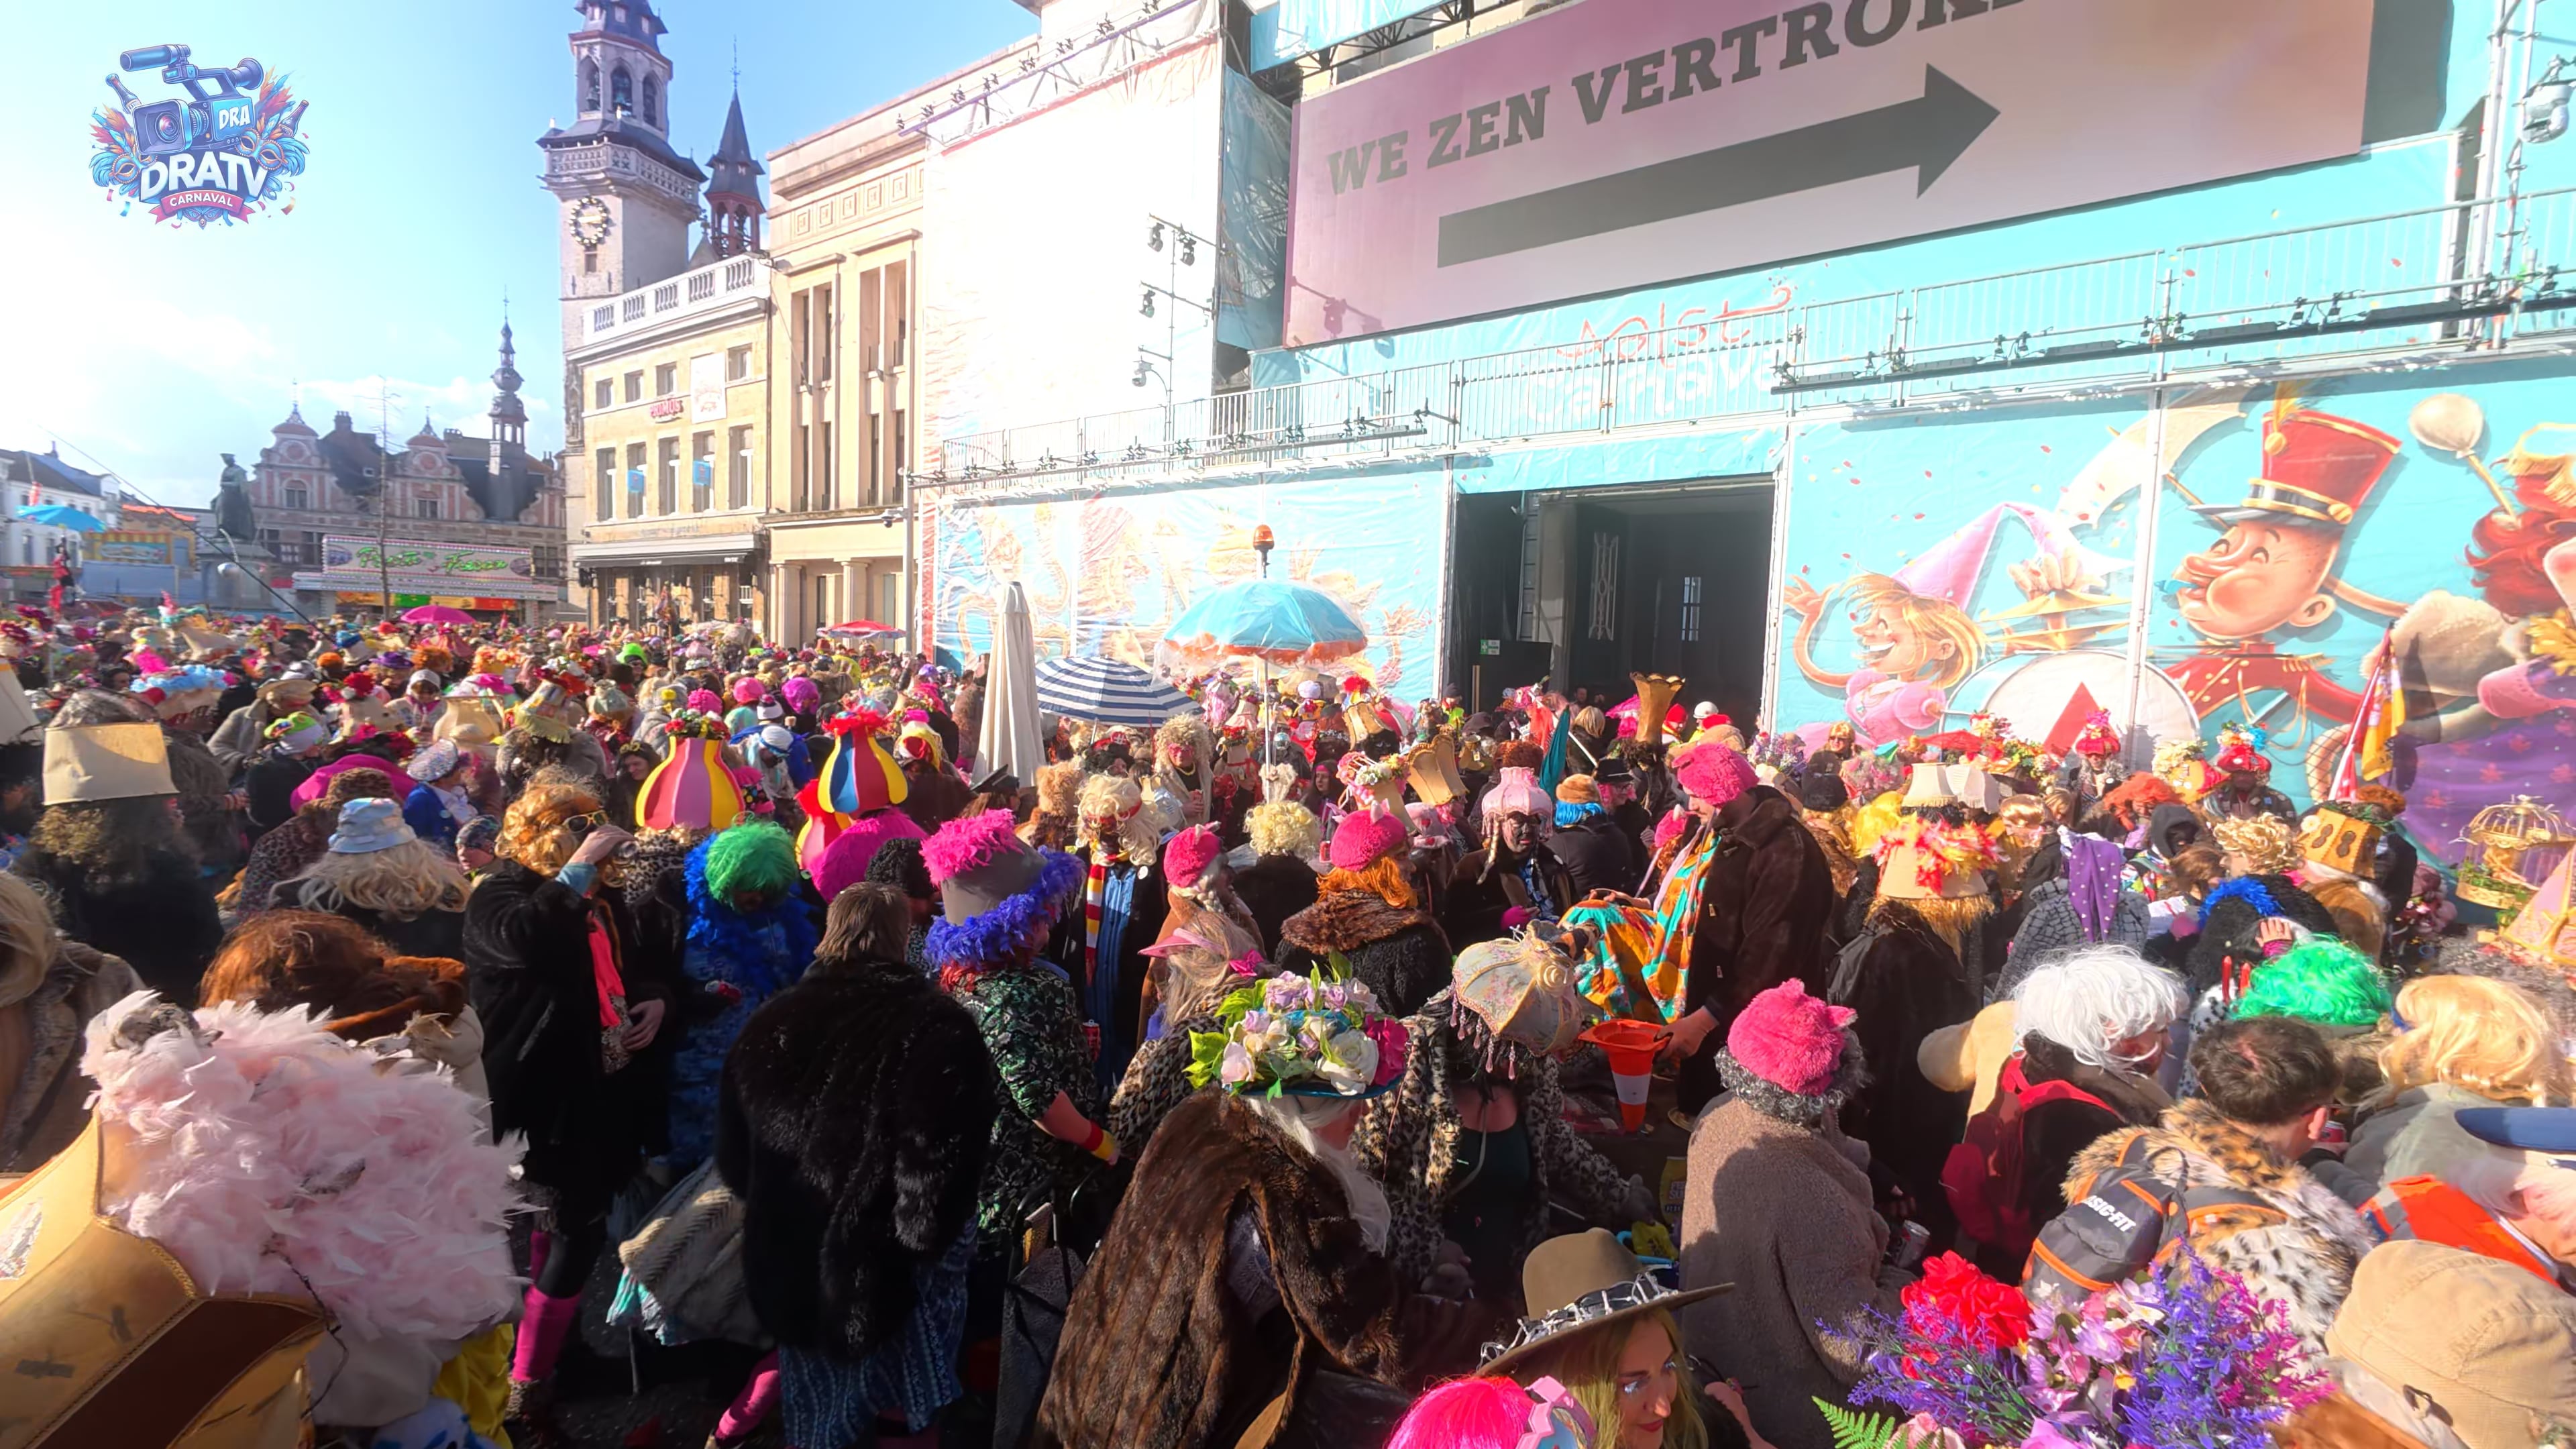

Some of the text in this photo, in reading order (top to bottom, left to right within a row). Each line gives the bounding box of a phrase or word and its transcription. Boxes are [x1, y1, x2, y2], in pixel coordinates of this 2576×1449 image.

[1327, 0, 2025, 196] WE ZEN VERTRO
